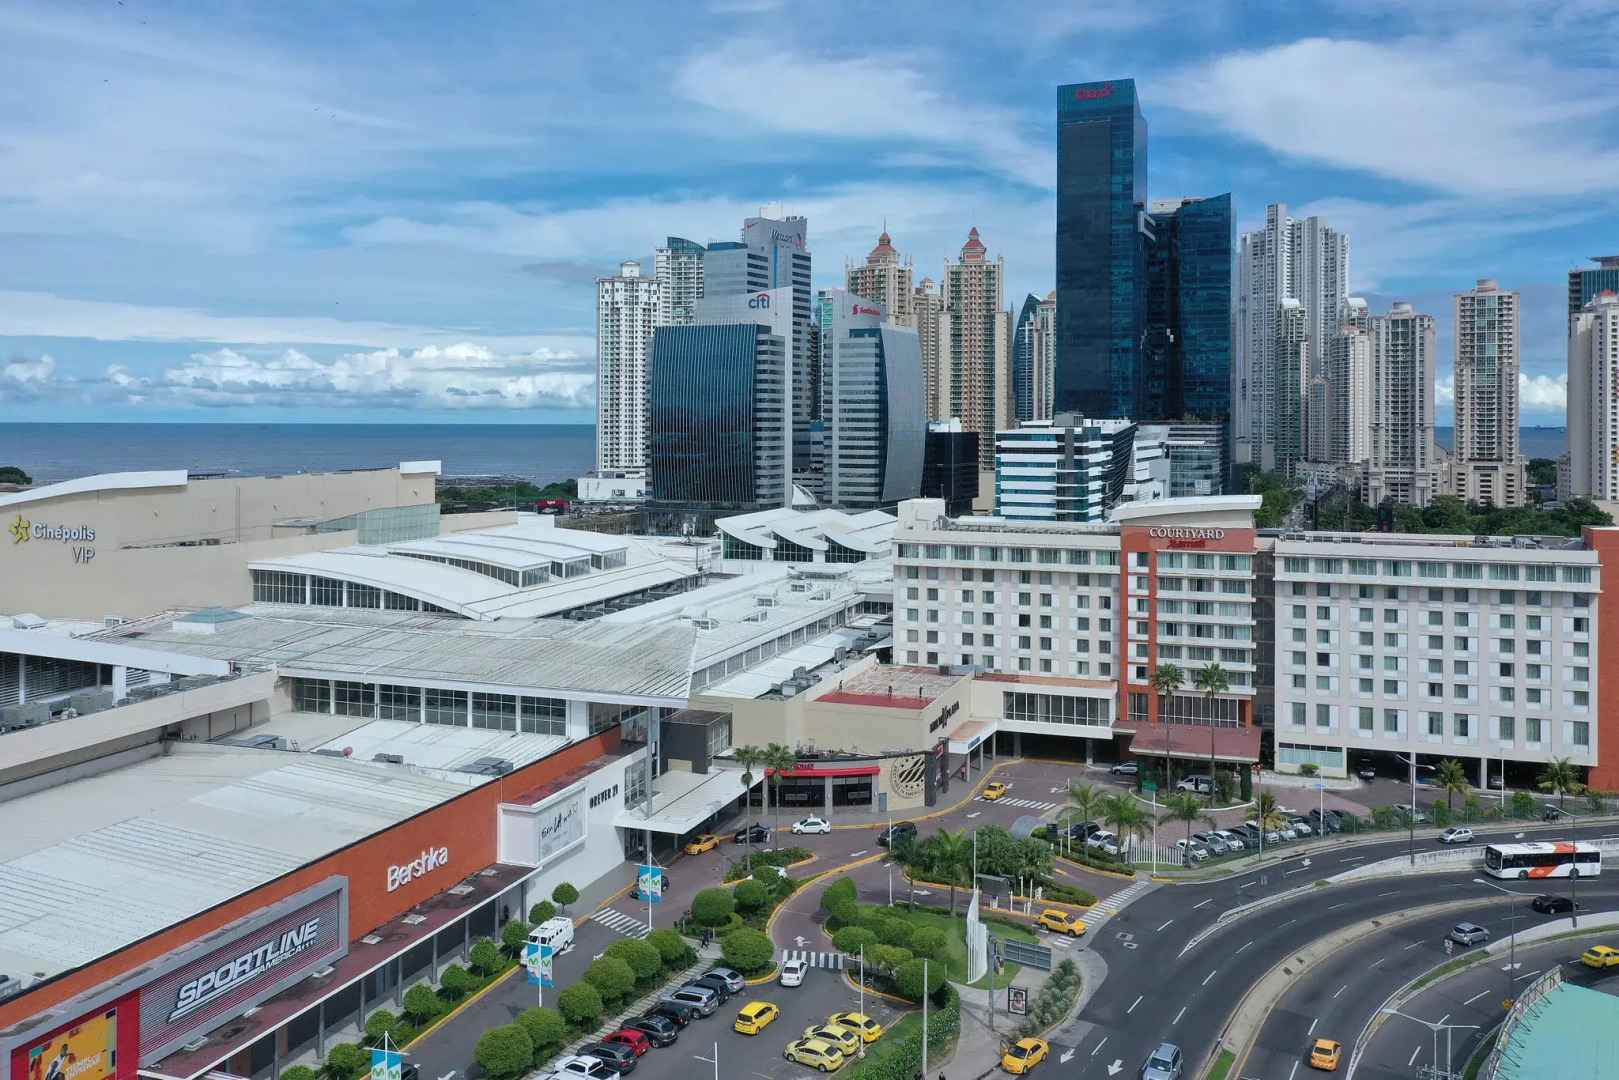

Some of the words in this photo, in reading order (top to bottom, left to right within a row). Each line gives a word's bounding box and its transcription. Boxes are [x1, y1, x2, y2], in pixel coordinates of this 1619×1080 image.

[33, 523, 96, 543] Cinépolis
[1149, 528, 1224, 539] COURTYARD
[72, 547, 95, 564] VIP
[387, 847, 448, 892] Bershka
[176, 917, 320, 1009] SPORTLINE
[257, 945, 302, 975] AMERICA
